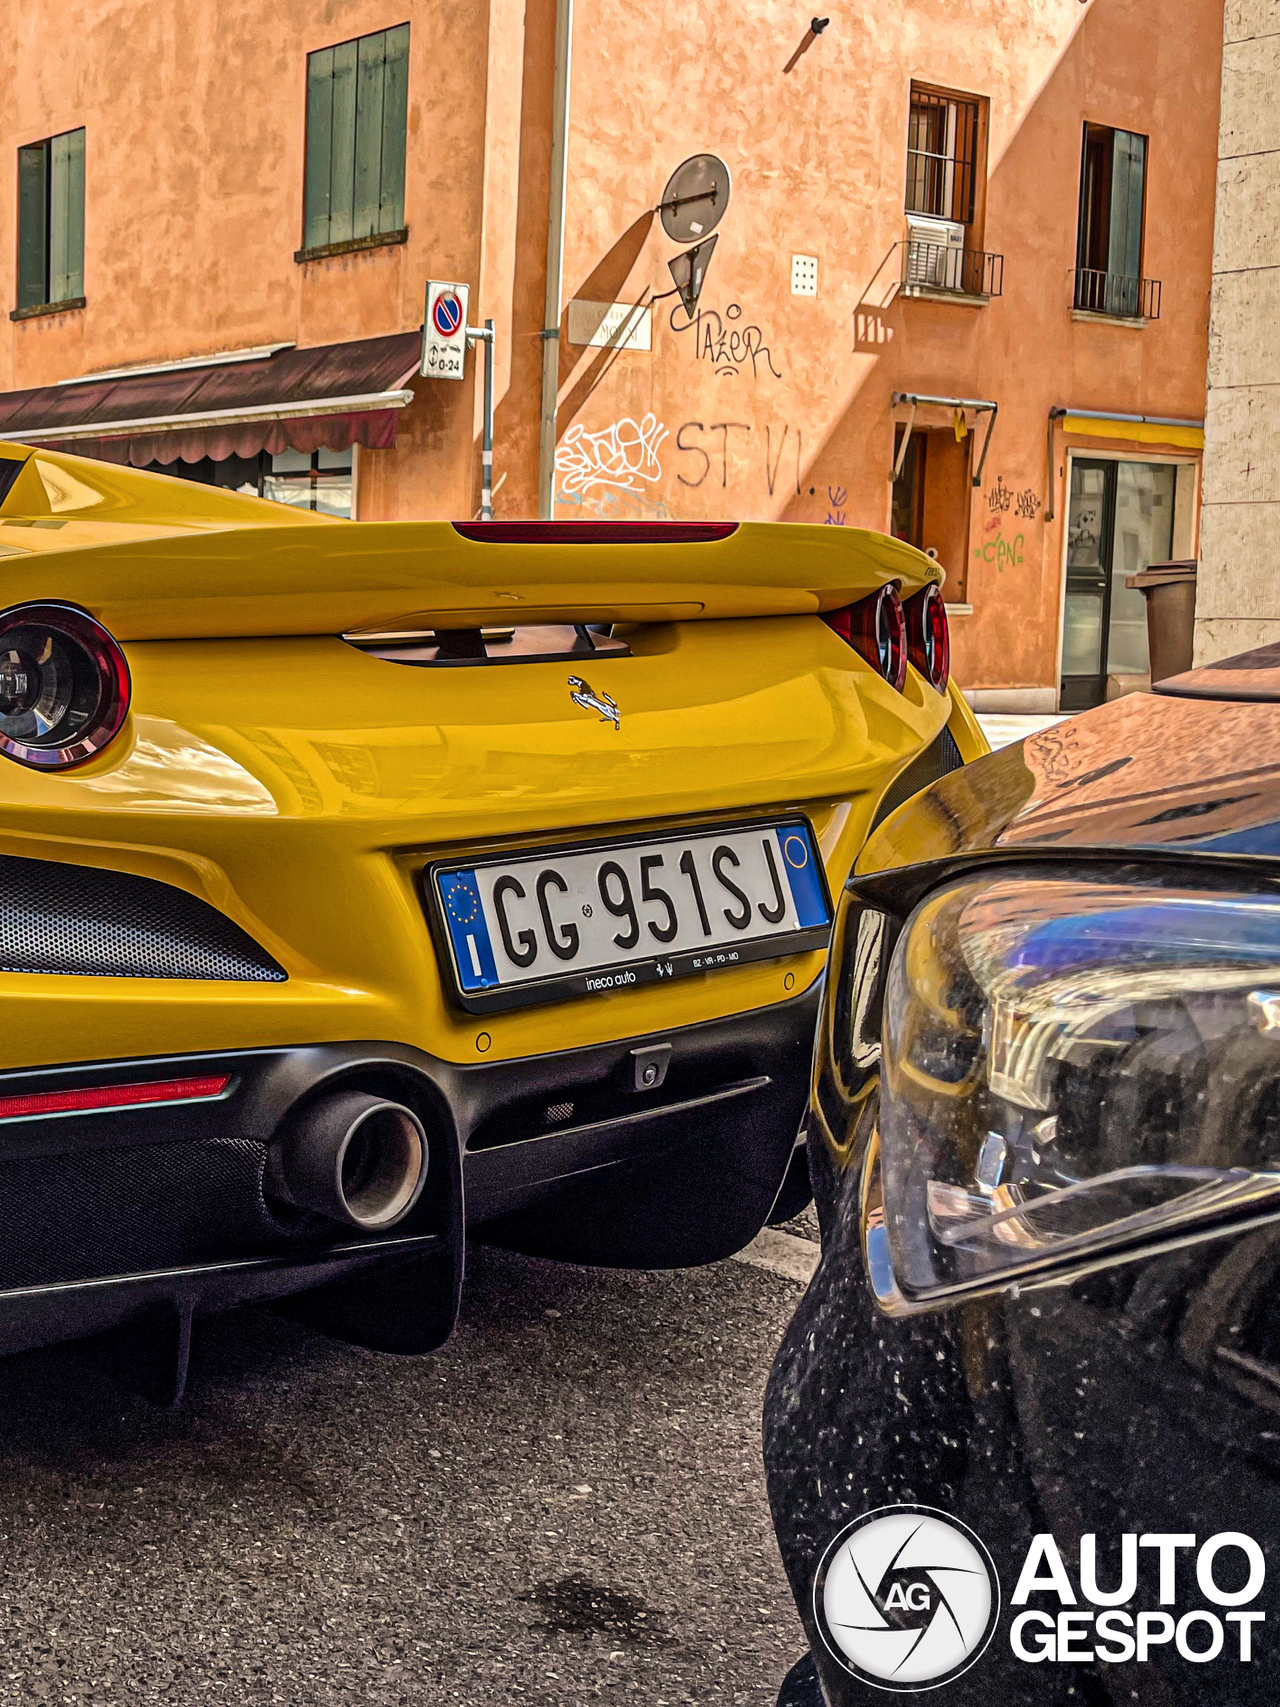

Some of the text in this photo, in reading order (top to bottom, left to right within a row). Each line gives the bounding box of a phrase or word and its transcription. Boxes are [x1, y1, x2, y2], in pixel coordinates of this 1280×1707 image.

[438, 359, 460, 371] 0-24
[493, 838, 786, 968] GG 951SJ
[585, 970, 637, 991] ineco auto
